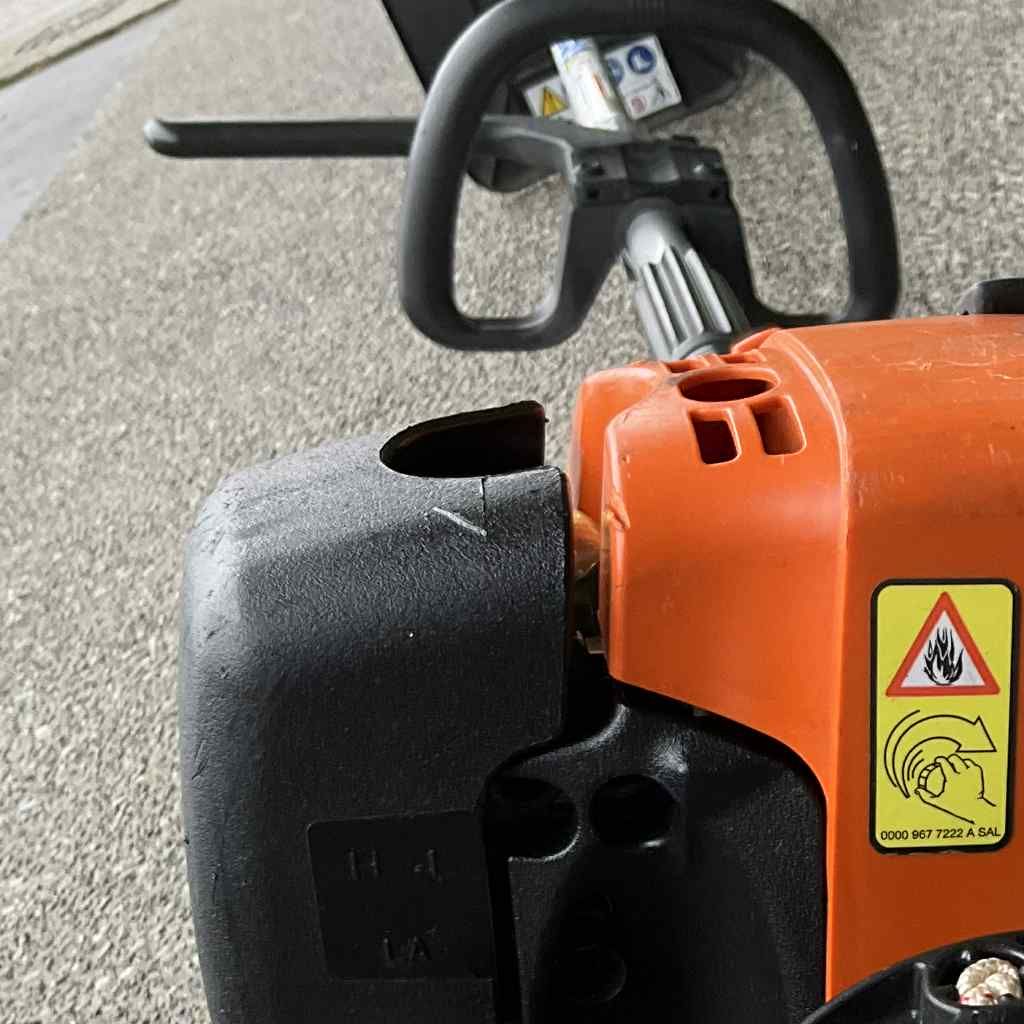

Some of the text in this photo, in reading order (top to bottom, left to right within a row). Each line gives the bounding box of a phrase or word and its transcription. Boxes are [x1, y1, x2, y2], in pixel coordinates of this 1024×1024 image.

[880, 827, 1000, 840] 0000 967 7222 A SAL
